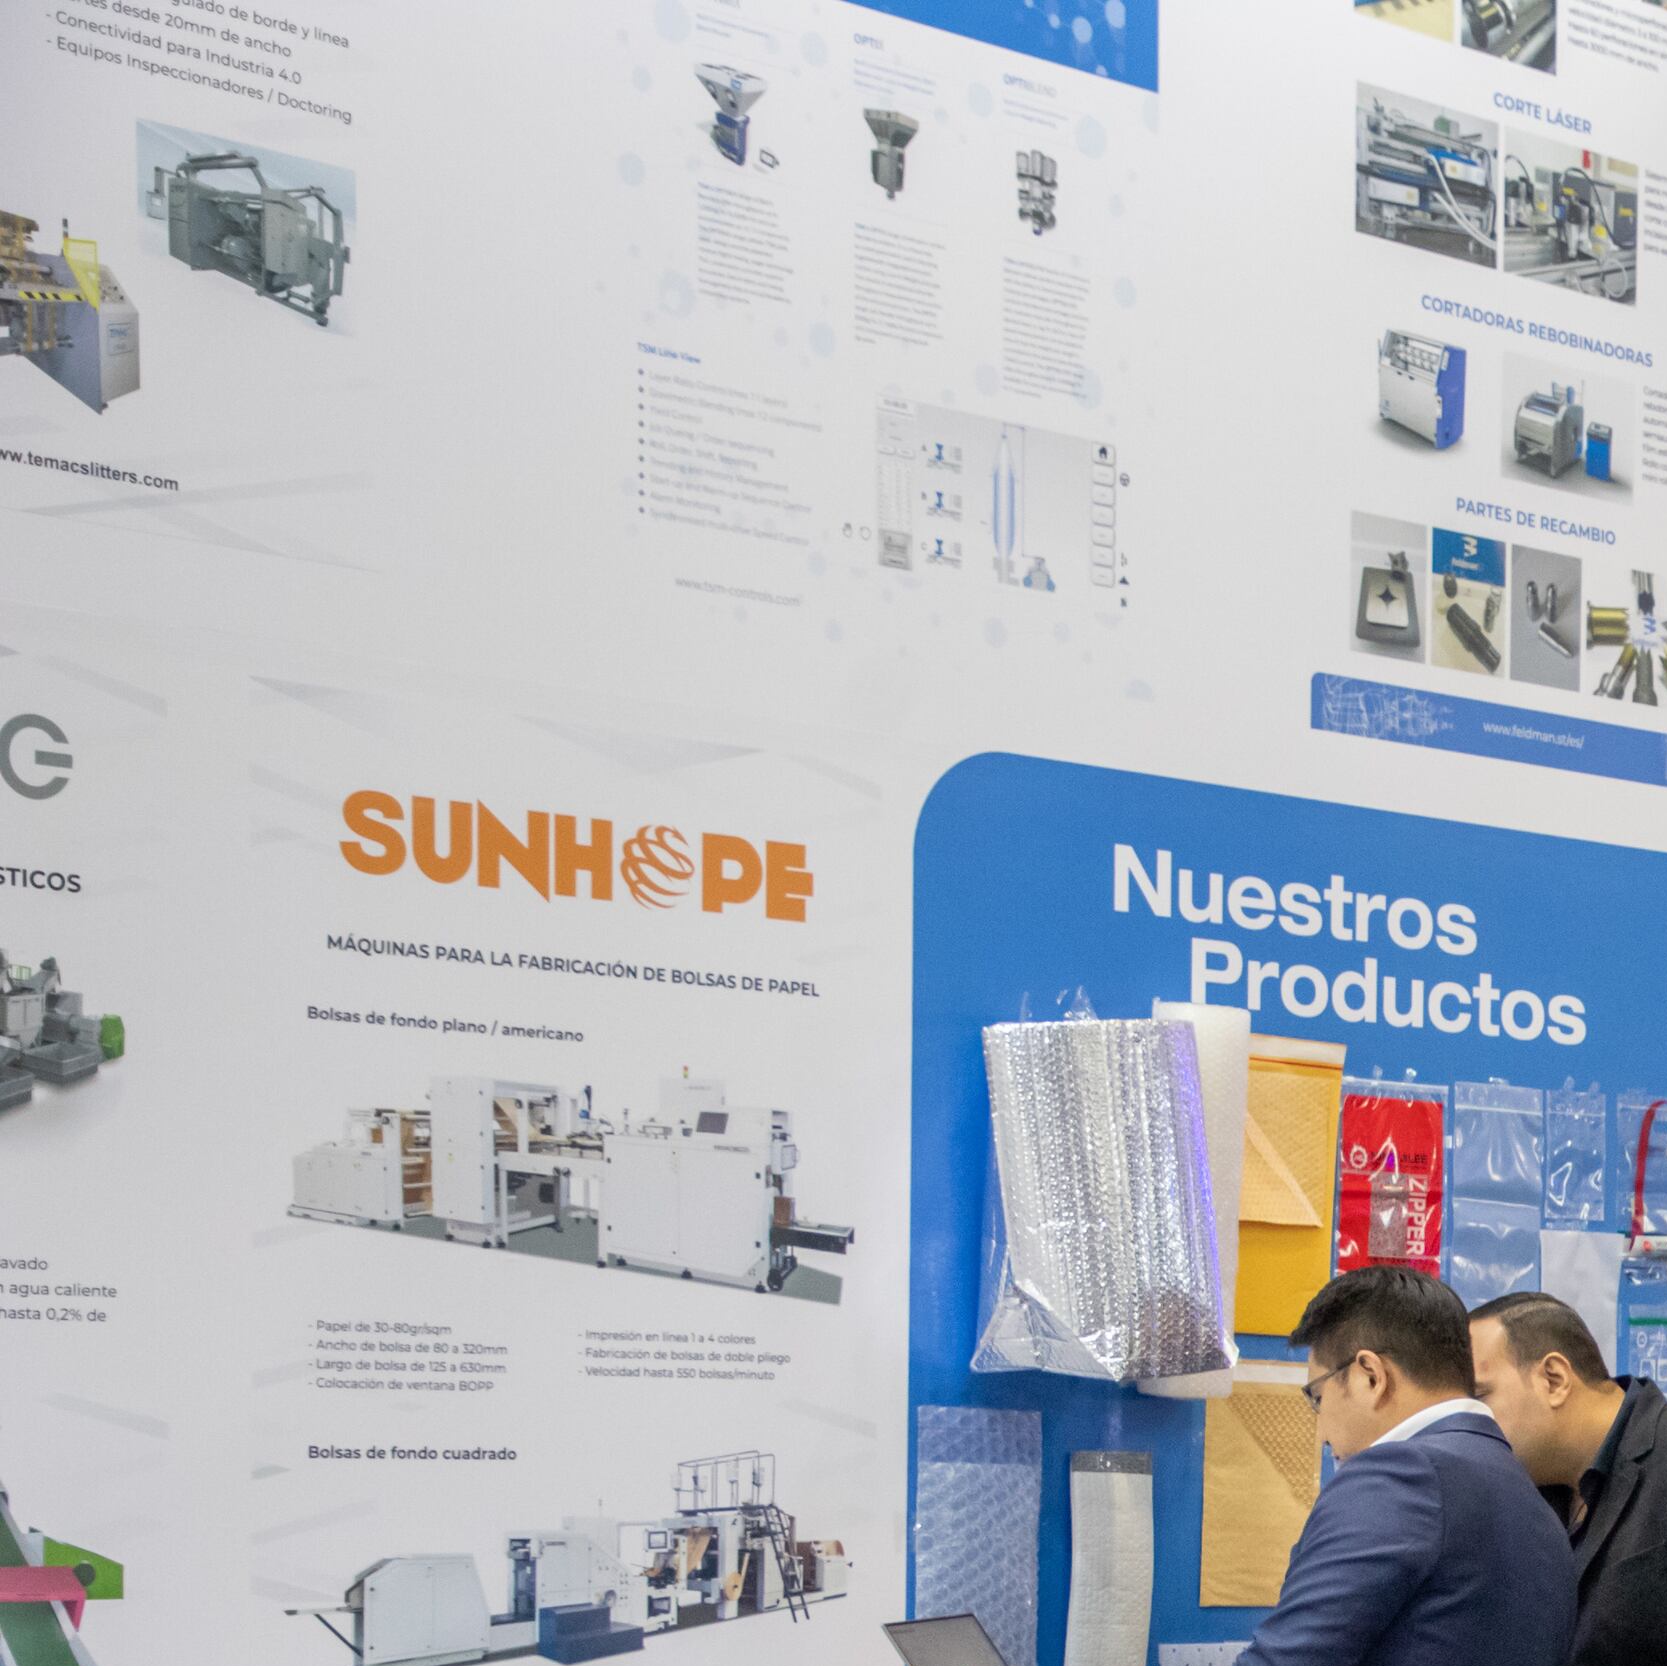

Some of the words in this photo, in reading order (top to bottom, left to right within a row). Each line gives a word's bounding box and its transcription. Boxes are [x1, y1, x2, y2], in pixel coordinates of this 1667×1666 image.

[112, 0, 160, 23] desde
[165, 14, 216, 38] 20mm
[220, 26, 240, 44] de
[244, 33, 292, 57] ancho
[230, 1, 249, 21] de
[254, 11, 298, 34] borde
[301, 27, 310, 39] y
[314, 25, 350, 48] línea
[56, 11, 161, 49] Conectividad
[167, 40, 202, 62] para
[206, 49, 275, 79] Industria
[278, 69, 302, 85] 4.0
[56, 36, 122, 66] Equipos
[127, 54, 264, 102] Inspeccionadores
[278, 92, 352, 125] Doctoring
[1494, 92, 1541, 120] CORTE
[1546, 108, 1592, 134] LÁSER
[1421, 295, 1524, 334] CORTADORAS
[1528, 322, 1653, 368] REBOBINADORAS
[1456, 497, 1512, 523] PARTES
[1516, 510, 1536, 528] DE
[1540, 515, 1617, 545] RECAMBIO
[340, 790, 814, 923] SUNHOPE
[1113, 843, 1478, 956] Nuestros
[326, 932, 430, 960] MÁQUINAS
[435, 946, 486, 966] PARA
[490, 951, 513, 968] LA
[518, 953, 638, 980] FABRICACIÓN
[643, 966, 667, 983] DE
[671, 968, 738, 990] BOLSAS
[741, 976, 764, 992] DE
[768, 979, 820, 998] PAPEL
[1191, 937, 1588, 1045] Productos
[307, 1005, 361, 1025] Bolsas
[366, 1010, 385, 1026] de
[390, 1012, 438, 1030] fondo
[442, 1017, 488, 1036] plano
[502, 1022, 584, 1042] americano
[1407, 1176, 1429, 1256] ZIPPER
[9, 1284, 50, 1299] agua
[54, 1283, 118, 1298] caliente
[87, 1309, 107, 1322] de
[316, 1320, 351, 1334] Papel
[354, 1321, 371, 1333] de
[316, 1339, 357, 1352] Ancho
[359, 1340, 376, 1352] de
[379, 1340, 411, 1353] bolsa
[414, 1341, 431, 1353] de
[585, 1329, 642, 1342] Impresión
[717, 1333, 757, 1345] colores
[585, 1347, 651, 1360] Fabricación
[670, 1350, 705, 1362] bolsas
[724, 1352, 755, 1363] doble
[757, 1353, 791, 1366] pliego
[315, 1358, 352, 1373] Largo
[355, 1359, 371, 1371] de
[374, 1360, 407, 1371] bolsa
[410, 1361, 426, 1372] de
[460, 1362, 508, 1374] 630mm
[316, 1377, 385, 1390] Colocación
[387, 1379, 404, 1390] de
[406, 1381, 456, 1391] ventana
[585, 1366, 641, 1378] Velocidad
[643, 1367, 674, 1378] hasta
[308, 1445, 361, 1459] Bolsas
[366, 1445, 386, 1459] de
[390, 1446, 439, 1460] fondo
[442, 1446, 518, 1461] cuadrado
